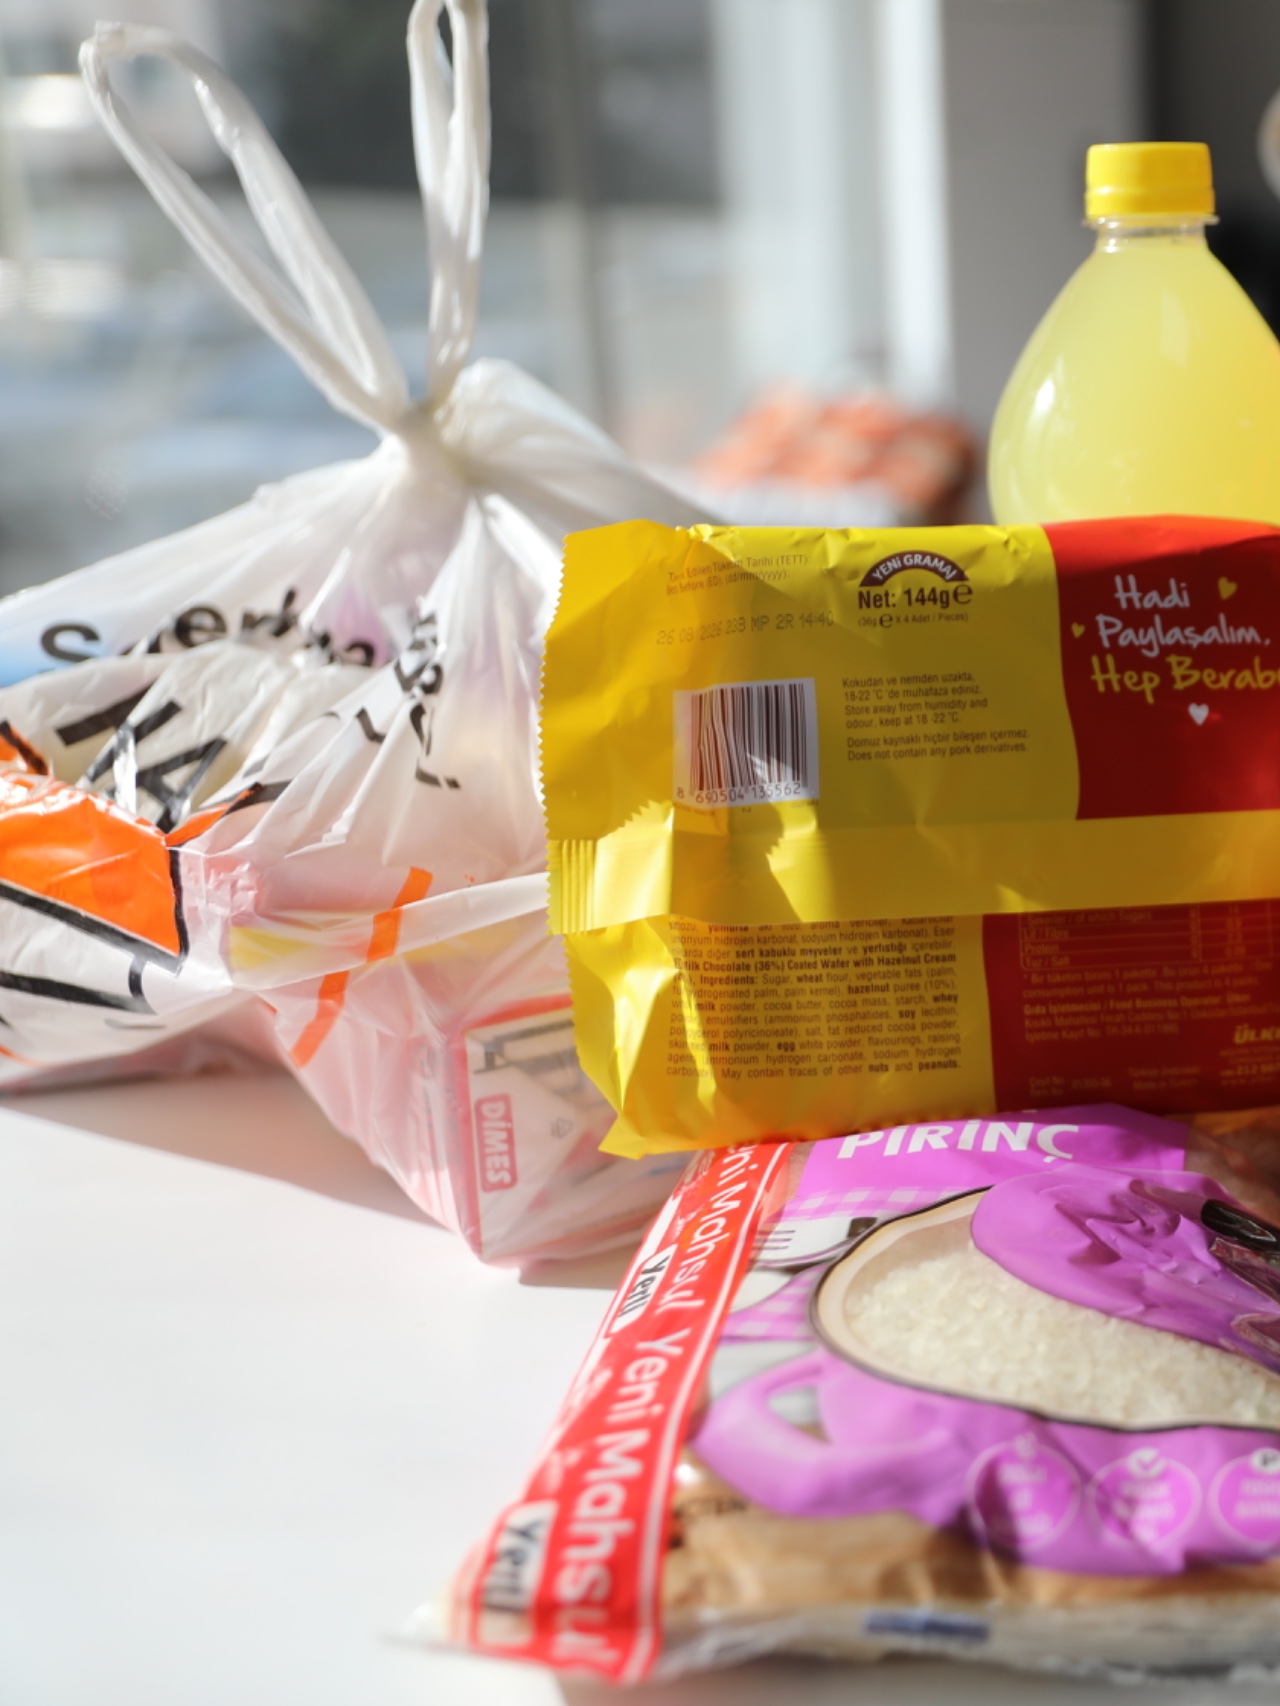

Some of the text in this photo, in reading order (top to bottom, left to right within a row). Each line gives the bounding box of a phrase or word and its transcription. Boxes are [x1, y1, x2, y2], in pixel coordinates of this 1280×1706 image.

[903, 553, 958, 580] GRAMAJ
[858, 590, 897, 609] Net:
[1114, 574, 1190, 609] Hadi
[911, 613, 930, 623] Adet
[842, 674, 939, 688] Kokudan ve nemden
[1091, 654, 1161, 704] Hep
[903, 686, 948, 698] muhafaza
[845, 697, 988, 716] Store away from humidity and
[880, 717, 901, 728] keep
[904, 716, 913, 725] at
[847, 737, 881, 748] Domuz
[924, 733, 950, 744] hiçbir
[954, 731, 987, 743] bileşen
[848, 750, 872, 762] Does
[875, 749, 890, 760] not
[893, 747, 928, 759] contain
[930, 746, 946, 758] any
[950, 744, 971, 756] pork
[934, 926, 954, 937] Eser
[736, 946, 842, 958] sert kabuklu meyveler
[703, 953, 956, 973] Chocolate (36%) Coated Wafer with Hazelnut Cream
[700, 967, 922, 986] Ingredients: wheat vegetable fats
[784, 982, 921, 998] palm hazelnut puree
[764, 993, 958, 1011] cocoa cocoa whey
[898, 1010, 916, 1020] soy
[845, 1023, 916, 1034] reduced cocoa
[709, 1033, 960, 1052] milk egg white raising
[766, 1048, 908, 1065] hydrogen sodium
[722, 1059, 961, 1080] May contain traces of other nuts and peanuts.
[482, 1100, 511, 1185] DİMES
[837, 1120, 1080, 1163] PİRİNÇ
[656, 1180, 743, 1313] Mahsul
[605, 1328, 692, 1424] Yeni
